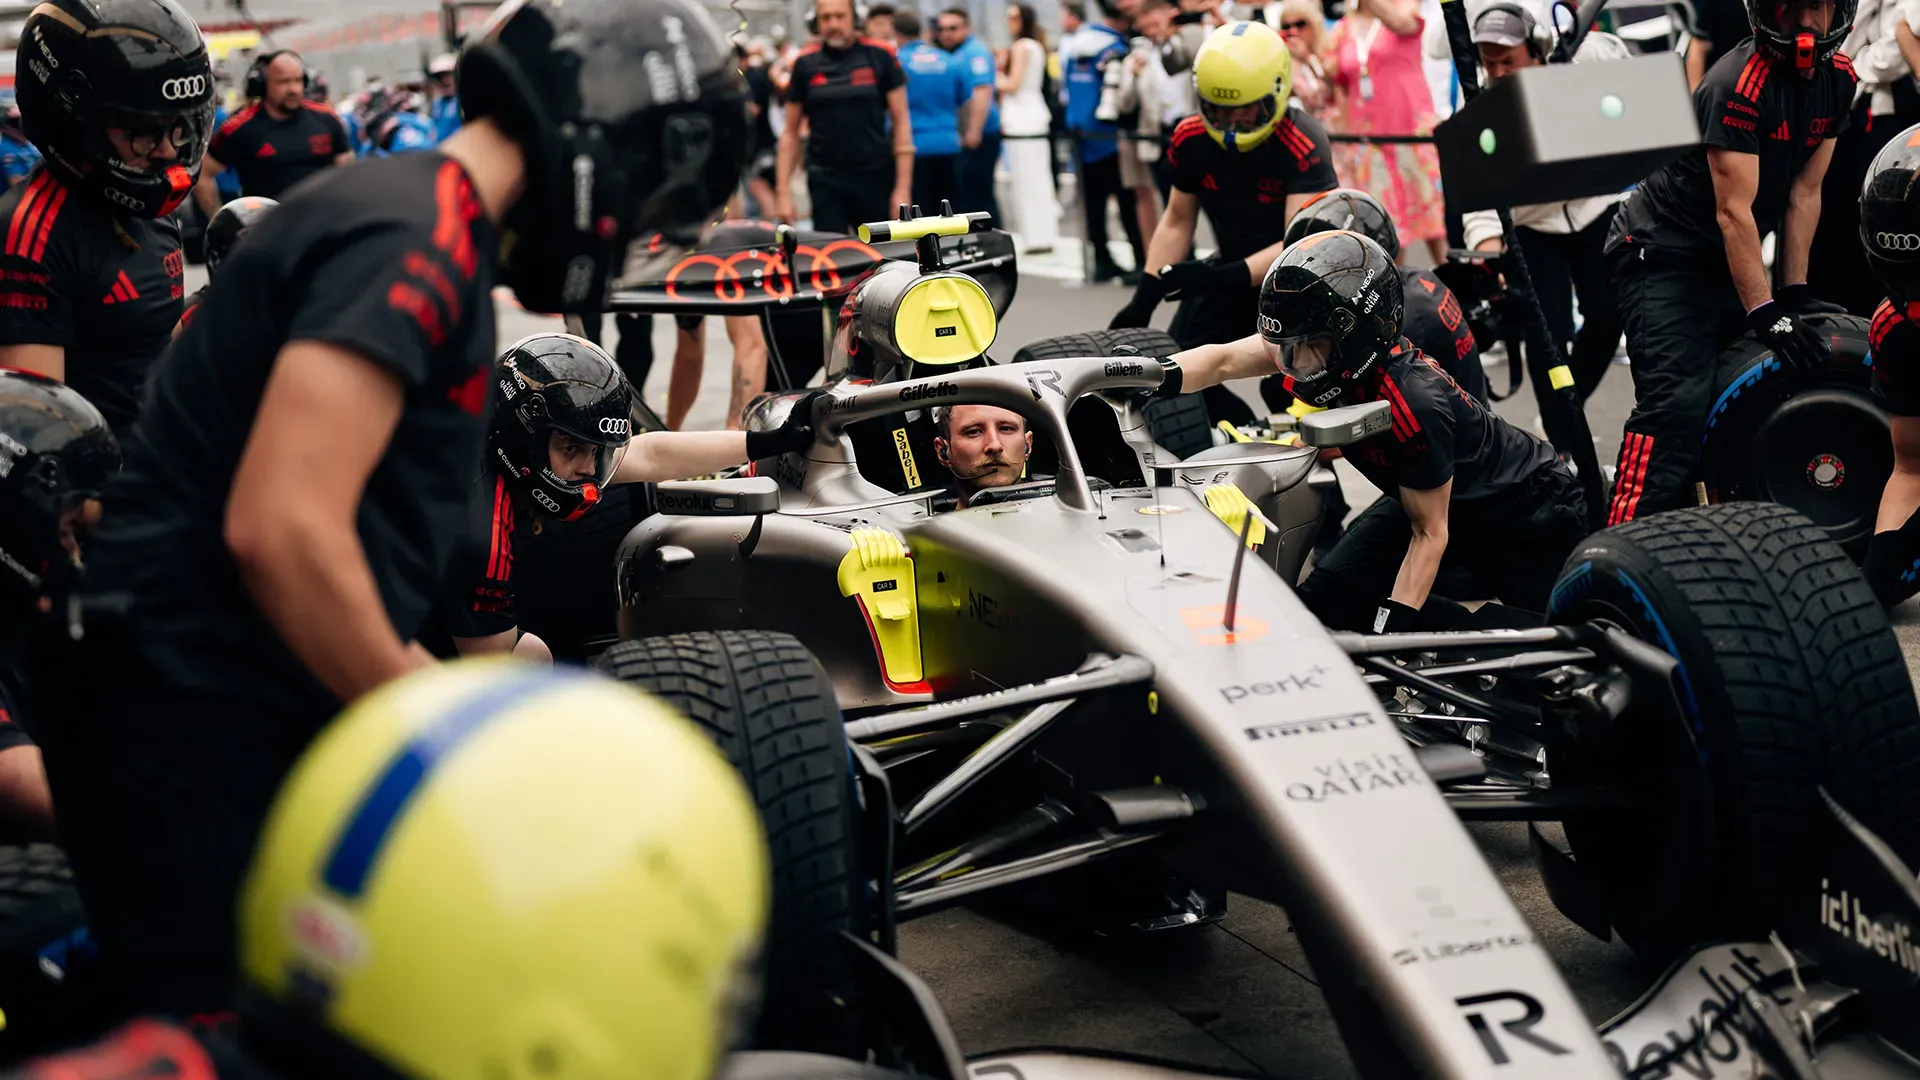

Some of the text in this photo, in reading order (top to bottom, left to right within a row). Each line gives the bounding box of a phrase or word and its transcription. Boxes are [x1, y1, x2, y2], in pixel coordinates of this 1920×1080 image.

[1360, 268, 1376, 292] NEXO
[1363, 291, 1380, 315] QATAR
[938, 329, 949, 337] CAR
[1103, 362, 1145, 379] Gillette
[1357, 351, 1379, 378] Castrol
[511, 367, 526, 390] NEXO
[898, 381, 959, 402] Gillette
[501, 454, 521, 479] Castrol
[895, 430, 918, 486] Sabelt
[876, 580, 893, 591] CAR 5
[1179, 603, 1271, 645] 5
[1243, 711, 1377, 742] PIRELLI
[1313, 750, 1406, 778] visit
[1285, 769, 1423, 803] QATAR
[1820, 876, 1851, 938] ic!
[1453, 988, 1575, 1066] R
